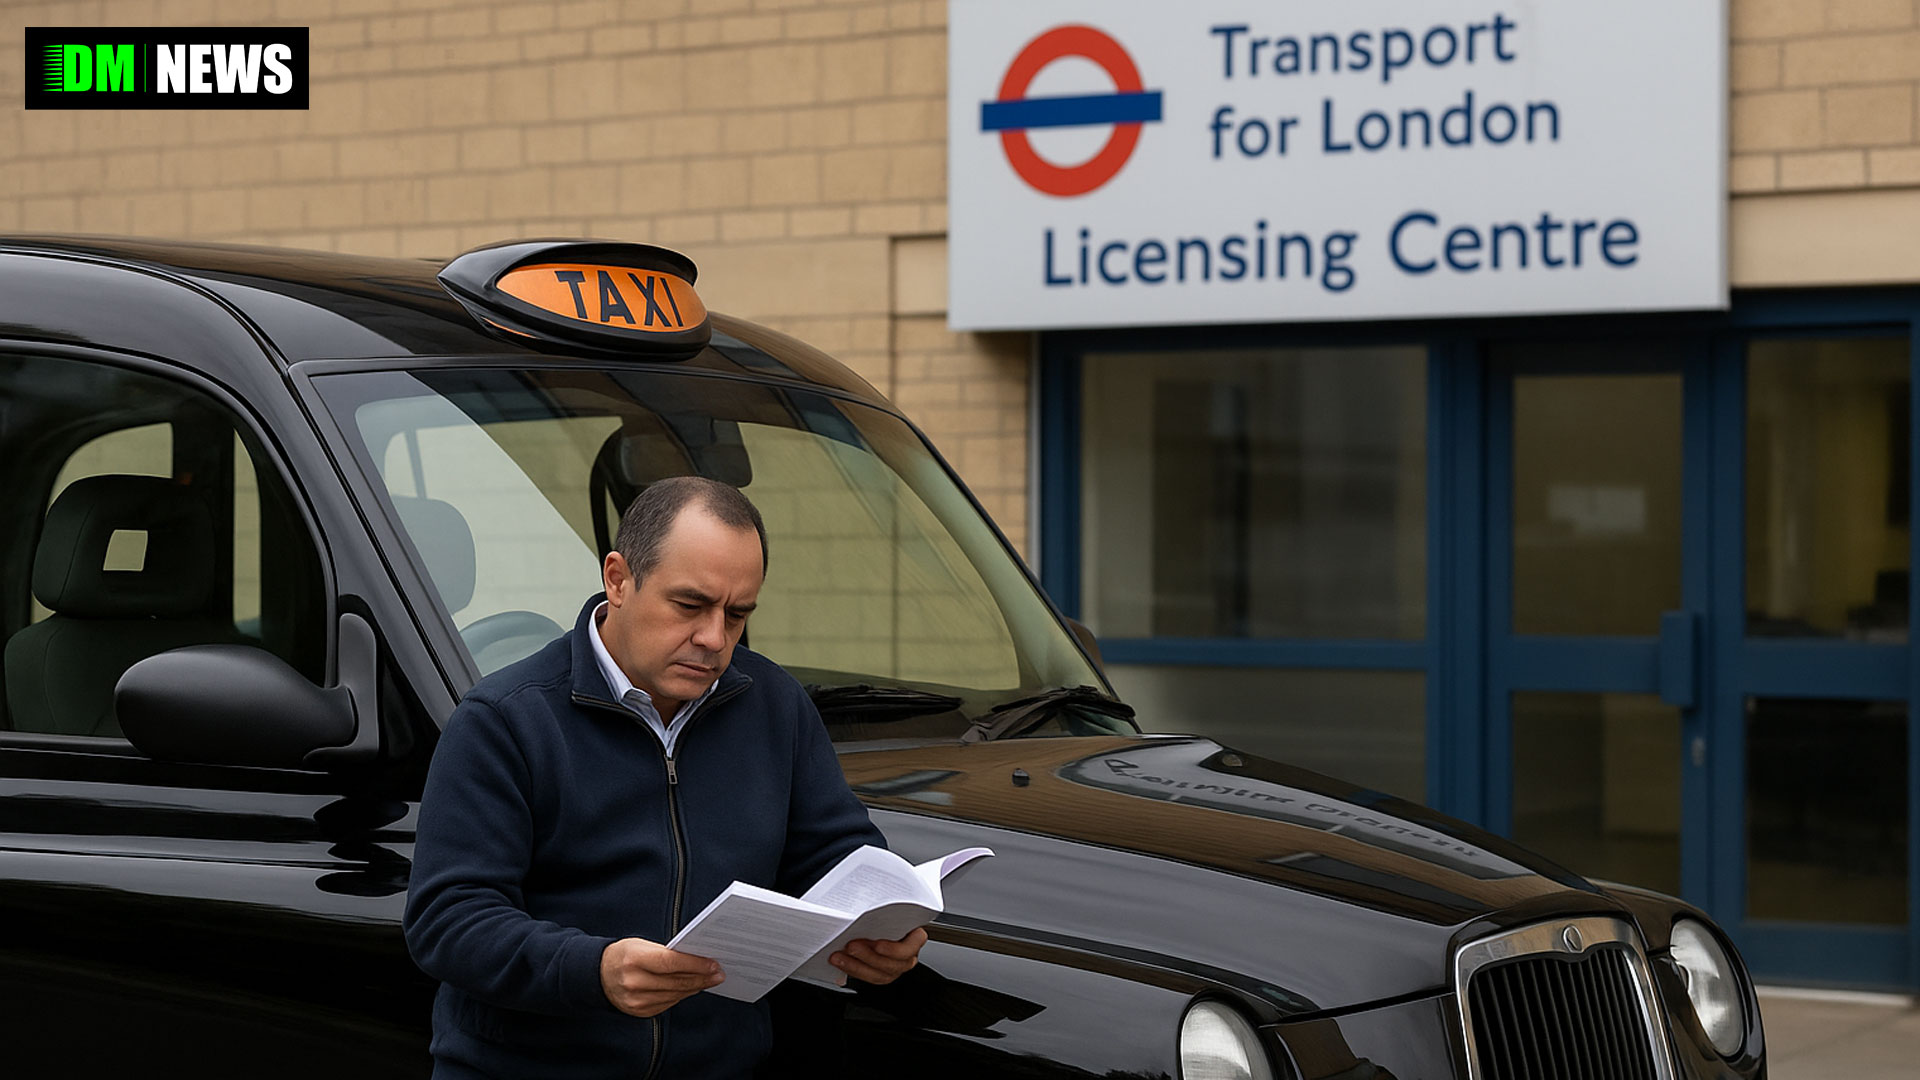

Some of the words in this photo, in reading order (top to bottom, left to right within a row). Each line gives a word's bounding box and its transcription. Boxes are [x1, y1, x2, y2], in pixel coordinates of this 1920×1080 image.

[1210, 14, 1516, 84] Transport
[1209, 105, 1299, 159] for
[1322, 91, 1560, 154] London
[1044, 219, 1359, 294] Licensing
[1388, 211, 1640, 276] Centre
[554, 270, 684, 327] TAXI
